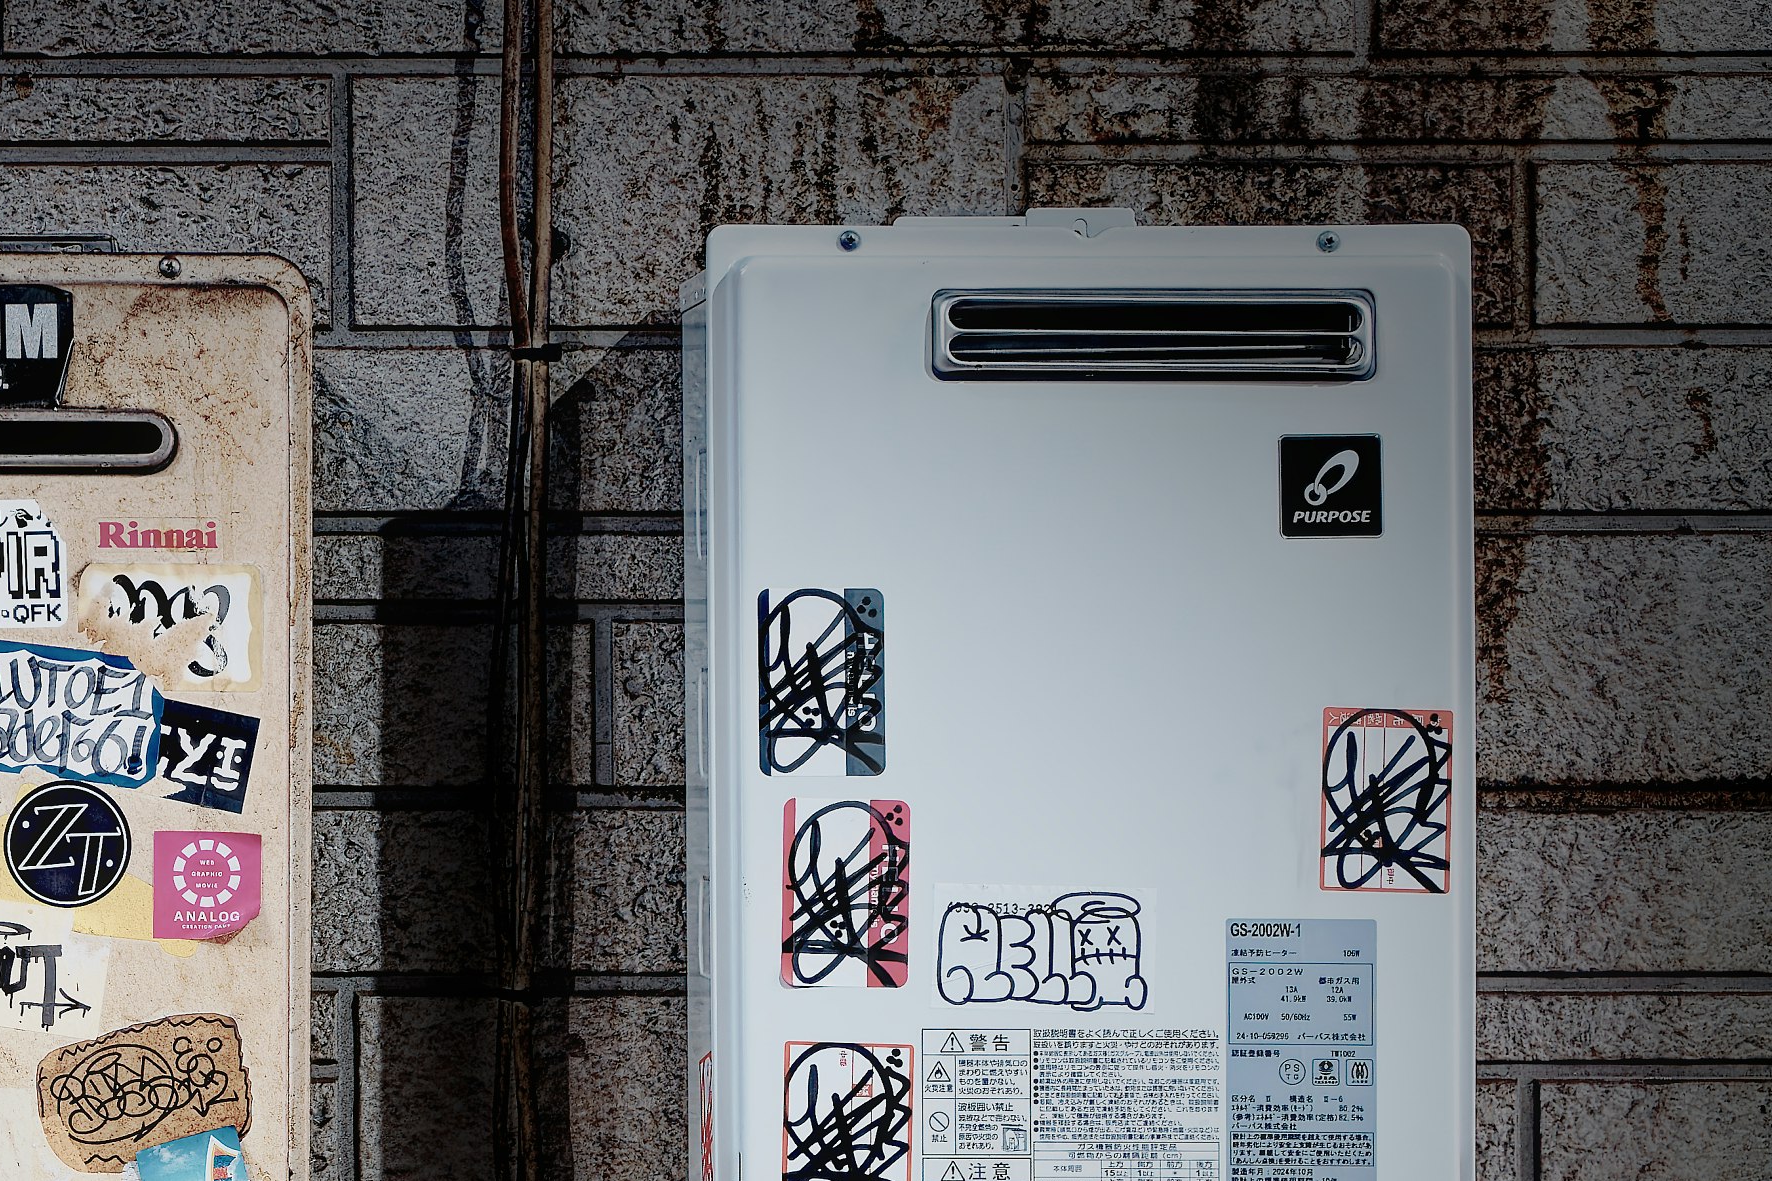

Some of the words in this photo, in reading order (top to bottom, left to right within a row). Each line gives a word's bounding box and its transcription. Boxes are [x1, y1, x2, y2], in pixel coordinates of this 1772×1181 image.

[1293, 510, 1371, 523] PURPOSE
[98, 521, 219, 550] Rinnai
[13, 603, 62, 625] QFK
[174, 911, 240, 922] ANALOG
[1230, 923, 1301, 938] GS-2002W-1
[969, 1033, 1010, 1052] 警告
[968, 1162, 1011, 1181] 注意
